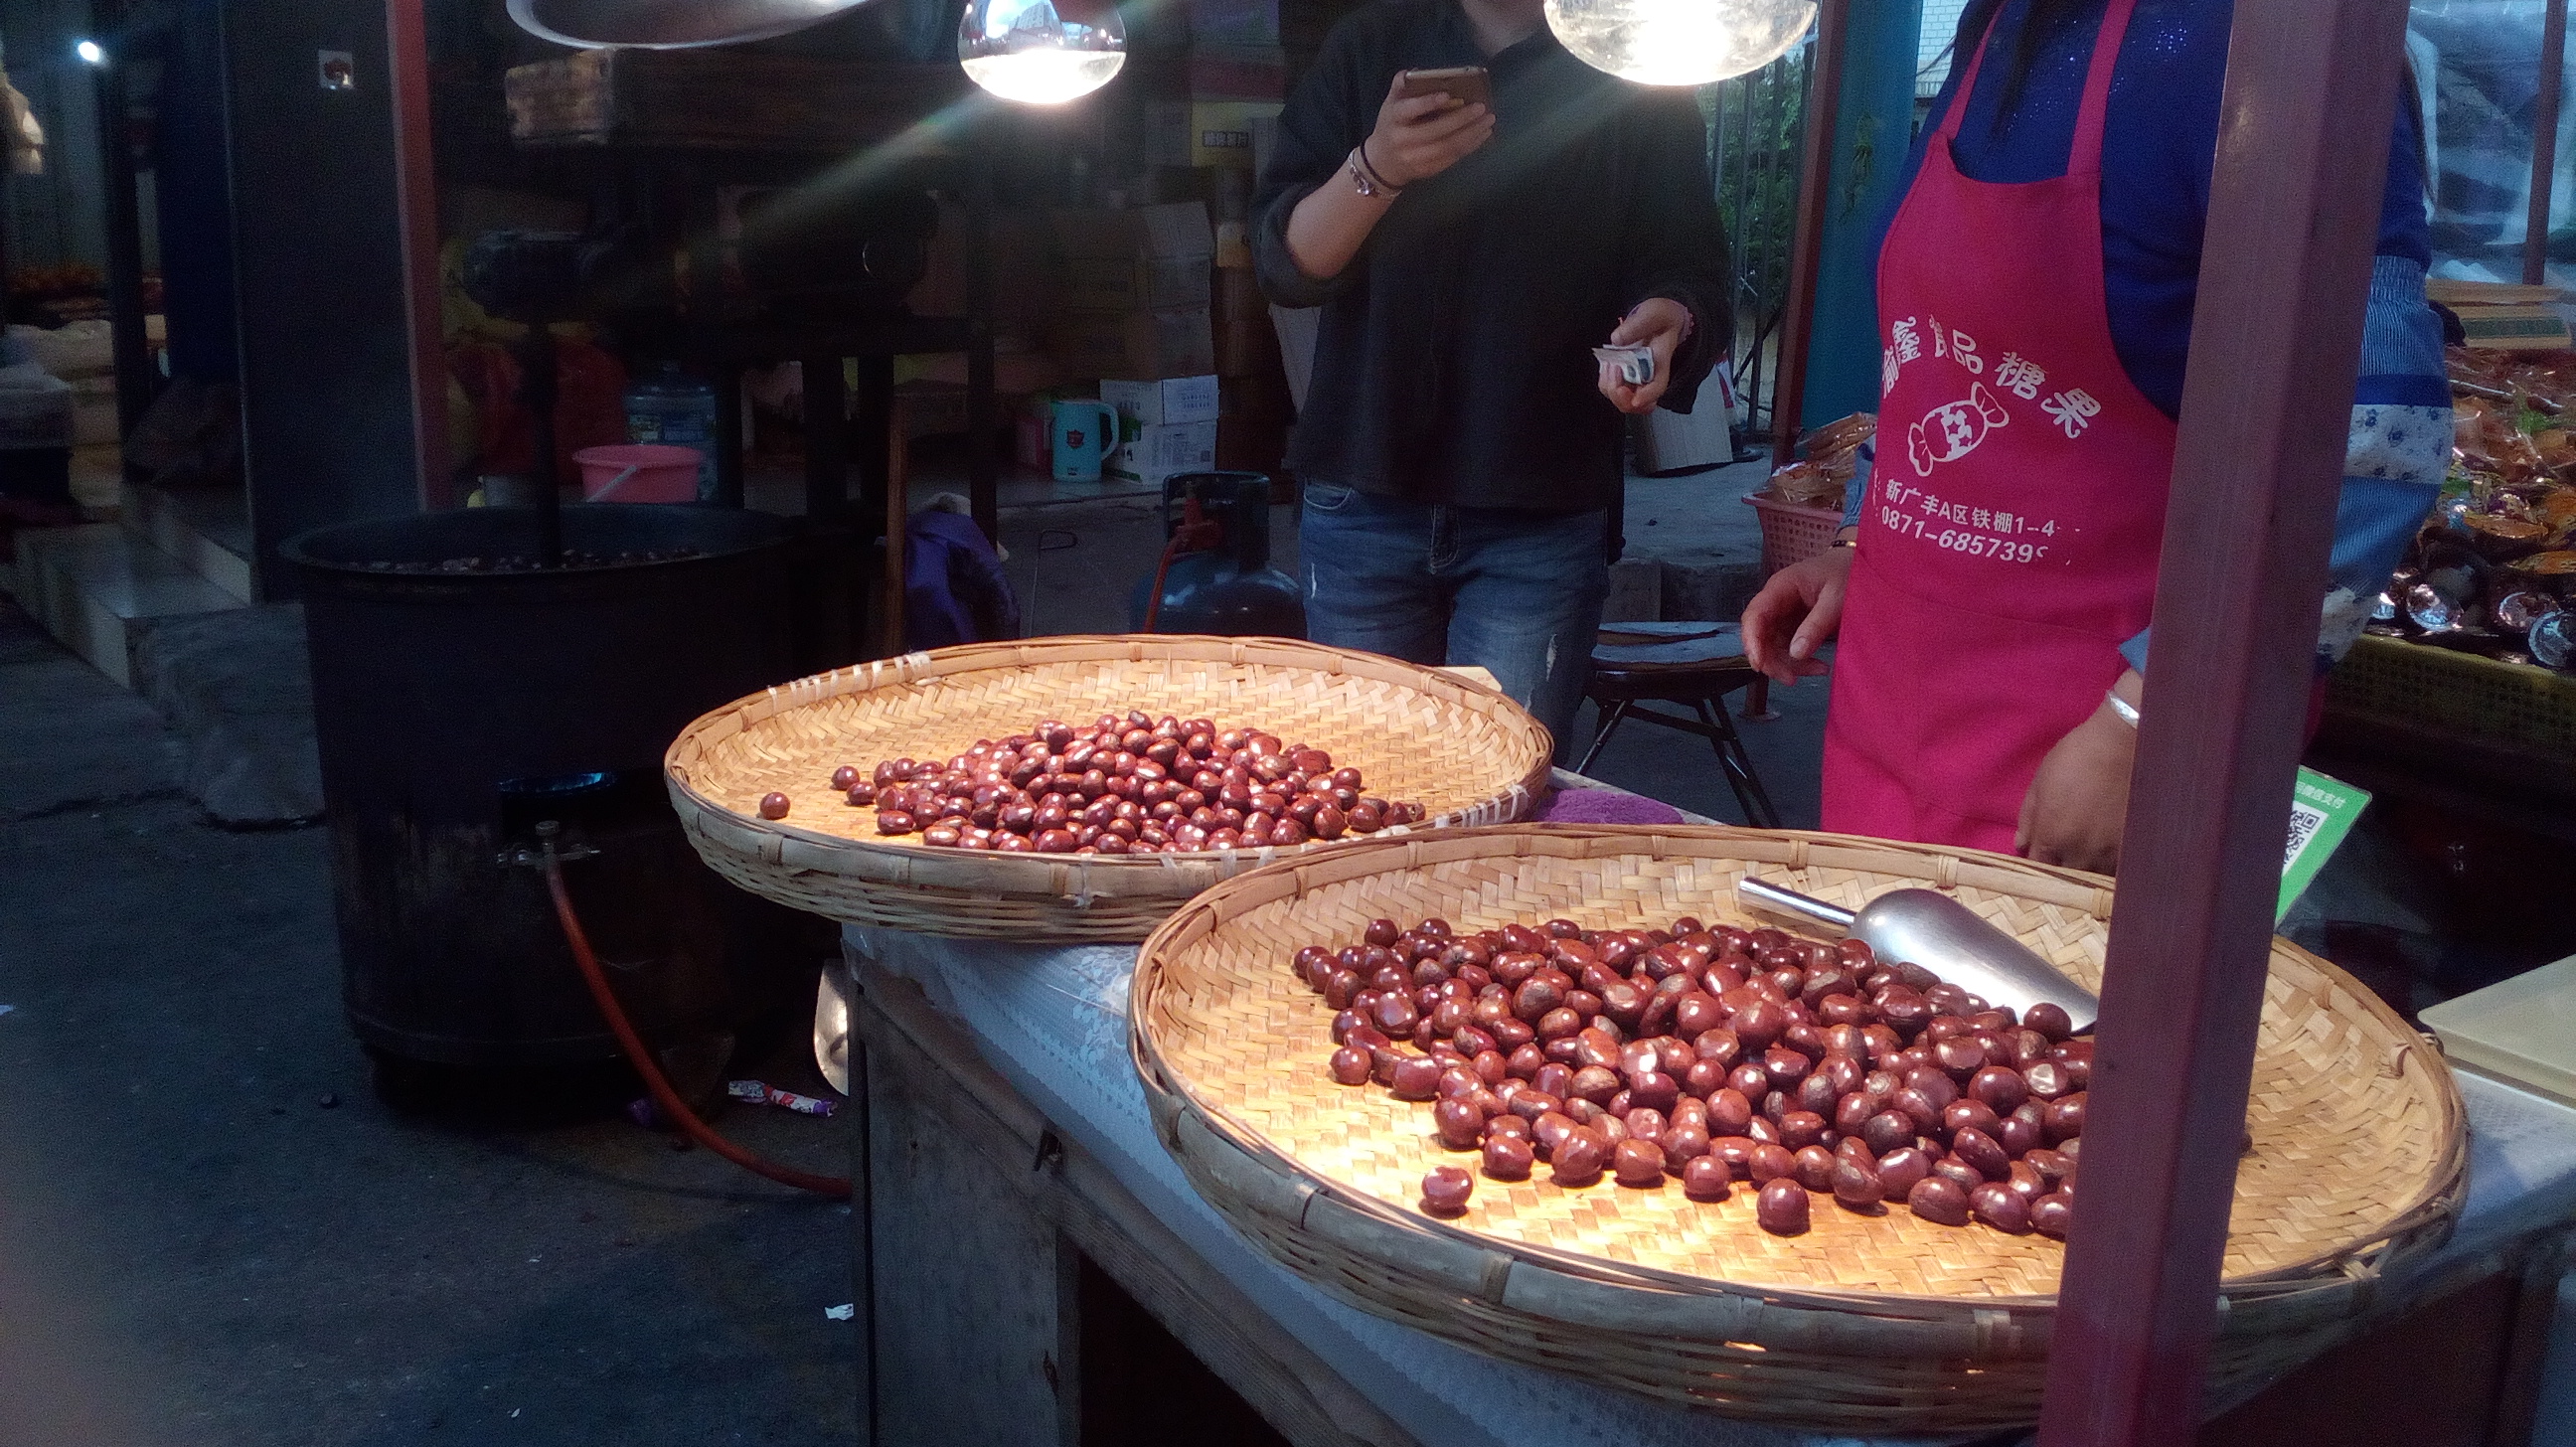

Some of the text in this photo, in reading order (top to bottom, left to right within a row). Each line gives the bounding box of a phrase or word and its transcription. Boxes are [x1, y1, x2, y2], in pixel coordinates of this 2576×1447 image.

[1881, 505, 2049, 563] 0871-685739
[1885, 479, 2057, 537] 新广丰A区铁棚1-4
